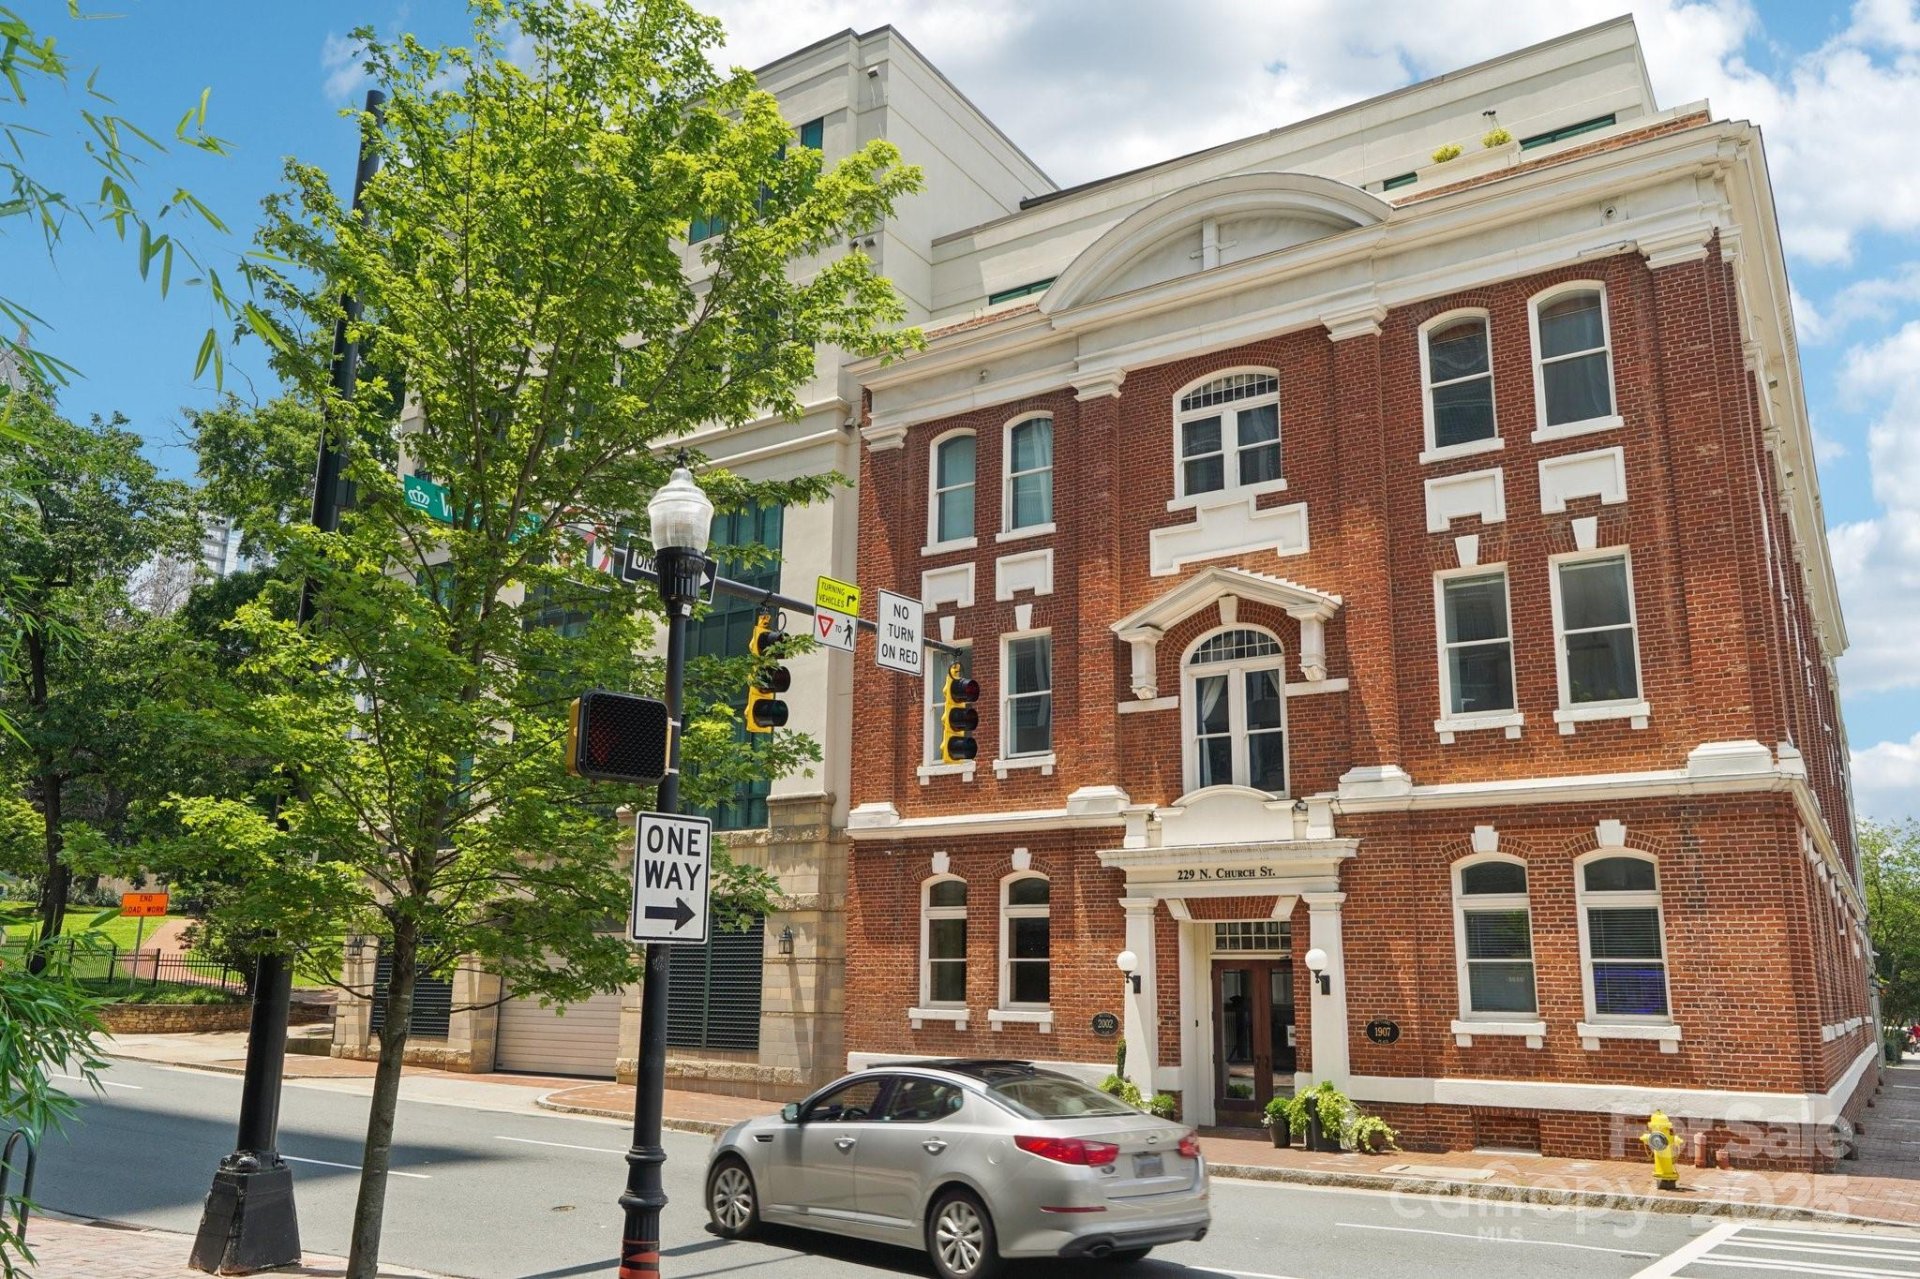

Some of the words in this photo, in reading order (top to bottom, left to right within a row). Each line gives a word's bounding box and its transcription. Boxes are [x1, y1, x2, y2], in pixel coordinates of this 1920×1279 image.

[821, 582, 846, 596] TURNING
[819, 594, 845, 608] VEHICLES
[893, 603, 909, 620] NO
[835, 624, 842, 633] TO
[888, 623, 914, 643] TURN
[881, 643, 896, 660] ON
[899, 648, 918, 665] RED
[647, 824, 701, 857] ONE
[644, 859, 702, 891] WAY
[1177, 869, 1195, 880] 229
[1199, 868, 1212, 879] N.
[126, 905, 141, 913] OAD
[146, 905, 165, 913] WORK
[1097, 1018, 1114, 1029] 2002
[1374, 1026, 1391, 1037] 1907
